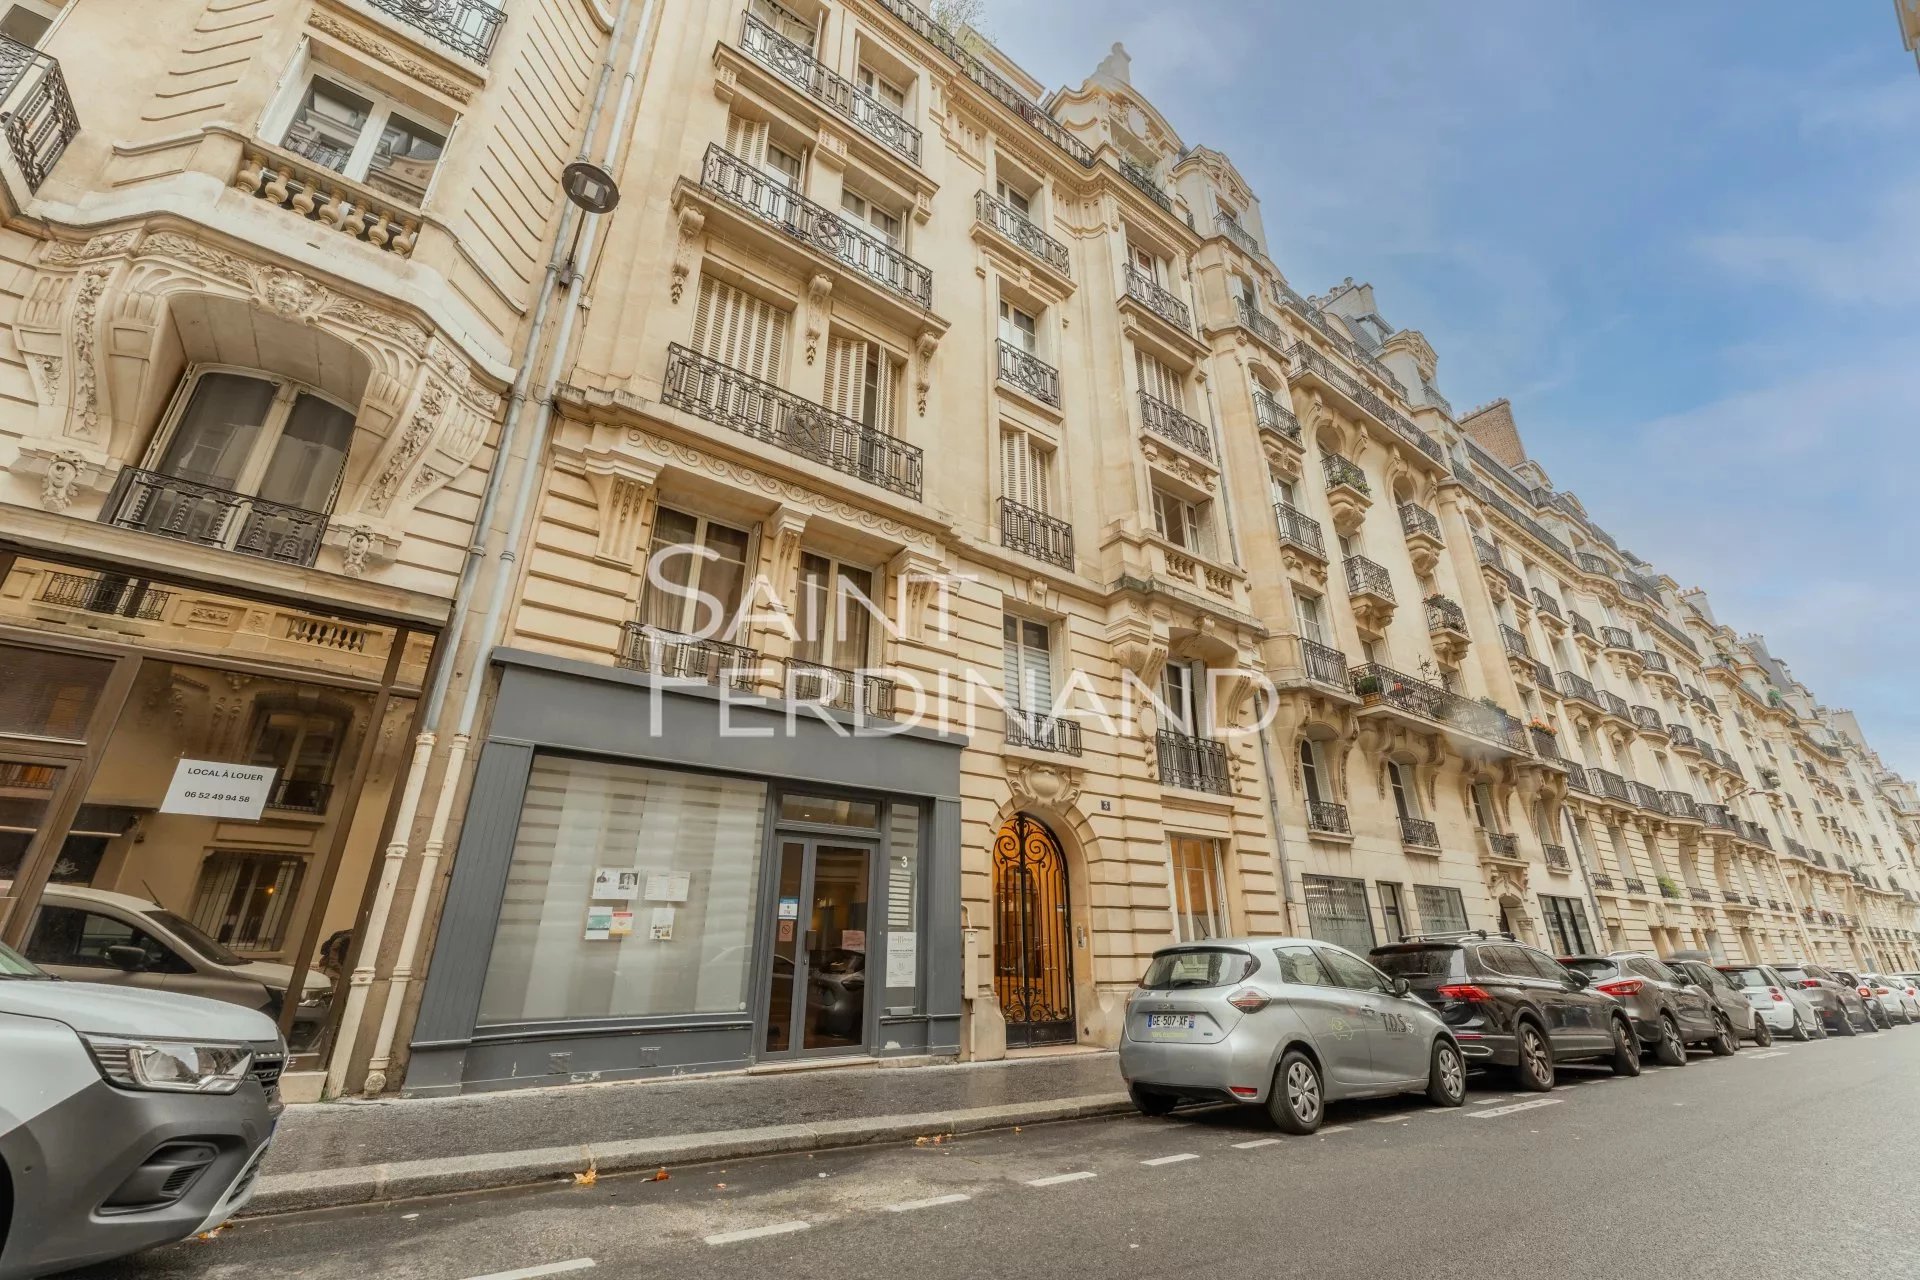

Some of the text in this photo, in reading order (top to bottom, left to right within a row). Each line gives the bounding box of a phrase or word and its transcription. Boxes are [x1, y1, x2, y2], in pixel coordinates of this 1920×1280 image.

[187, 767, 264, 781] LOCAL À LOUER
[184, 790, 196, 798] 06
[211, 793, 224, 801] 49
[225, 794, 237, 802] 94
[238, 795, 250, 803] 58
[901, 855, 908, 868] 3
